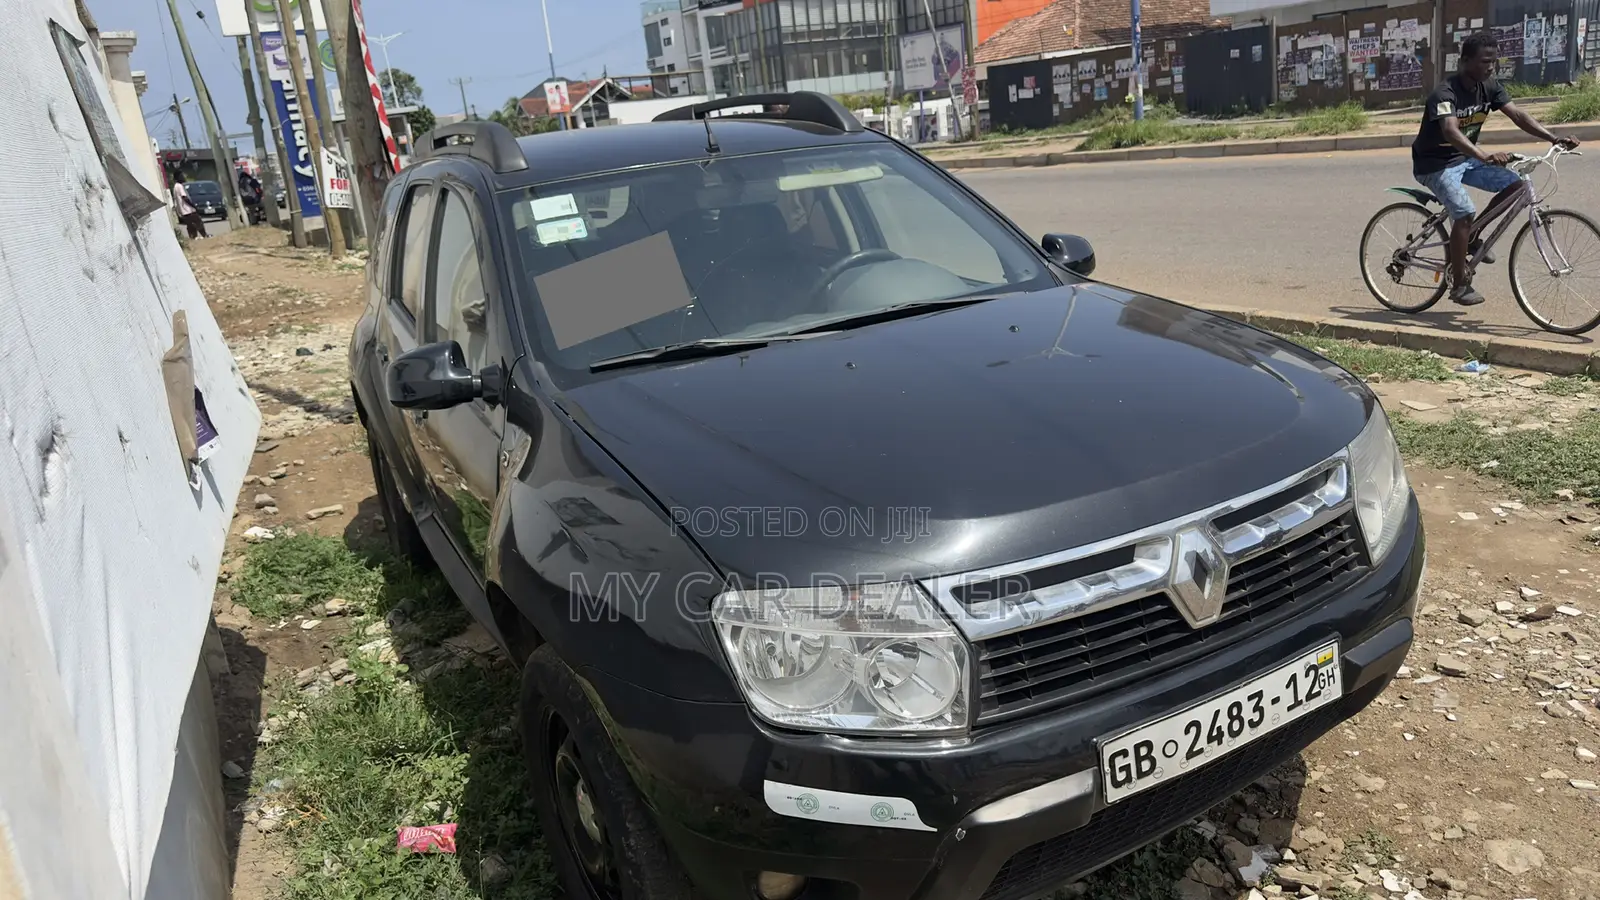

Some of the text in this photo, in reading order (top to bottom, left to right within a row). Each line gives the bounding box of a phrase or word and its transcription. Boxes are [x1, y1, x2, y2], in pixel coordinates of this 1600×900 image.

[1350, 49, 1379, 57] WANTED
[1108, 663, 1336, 789] GB 2483-12 GH
